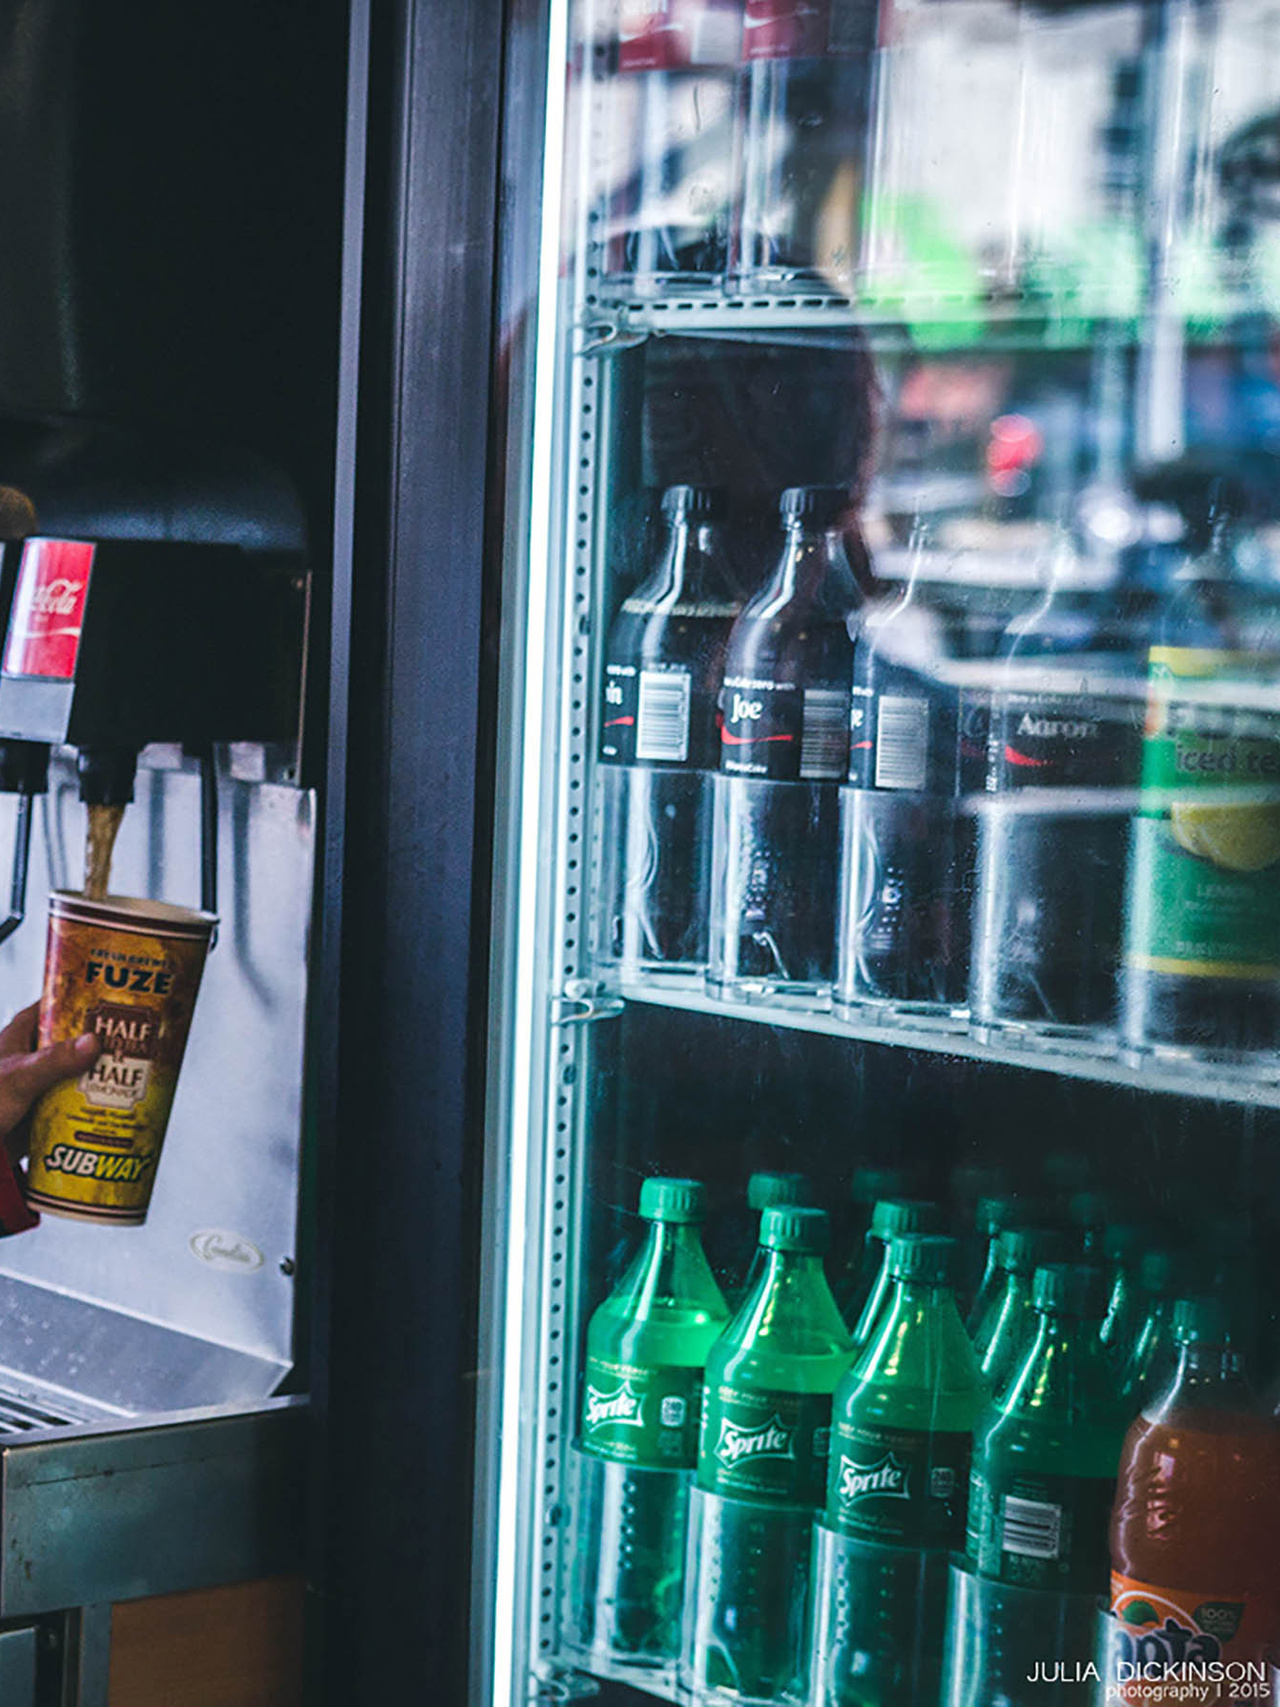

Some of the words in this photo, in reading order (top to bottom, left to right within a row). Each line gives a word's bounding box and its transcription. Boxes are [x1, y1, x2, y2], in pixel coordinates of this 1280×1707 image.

[730, 693, 763, 724] Joe
[86, 961, 172, 995] FUZE
[95, 1016, 152, 1041] HALF
[88, 1064, 144, 1087] HALF
[45, 1145, 151, 1180] SUBWAY
[585, 1391, 637, 1425] Sprite
[719, 1424, 788, 1461] Sprite
[839, 1463, 902, 1498] Sprite
